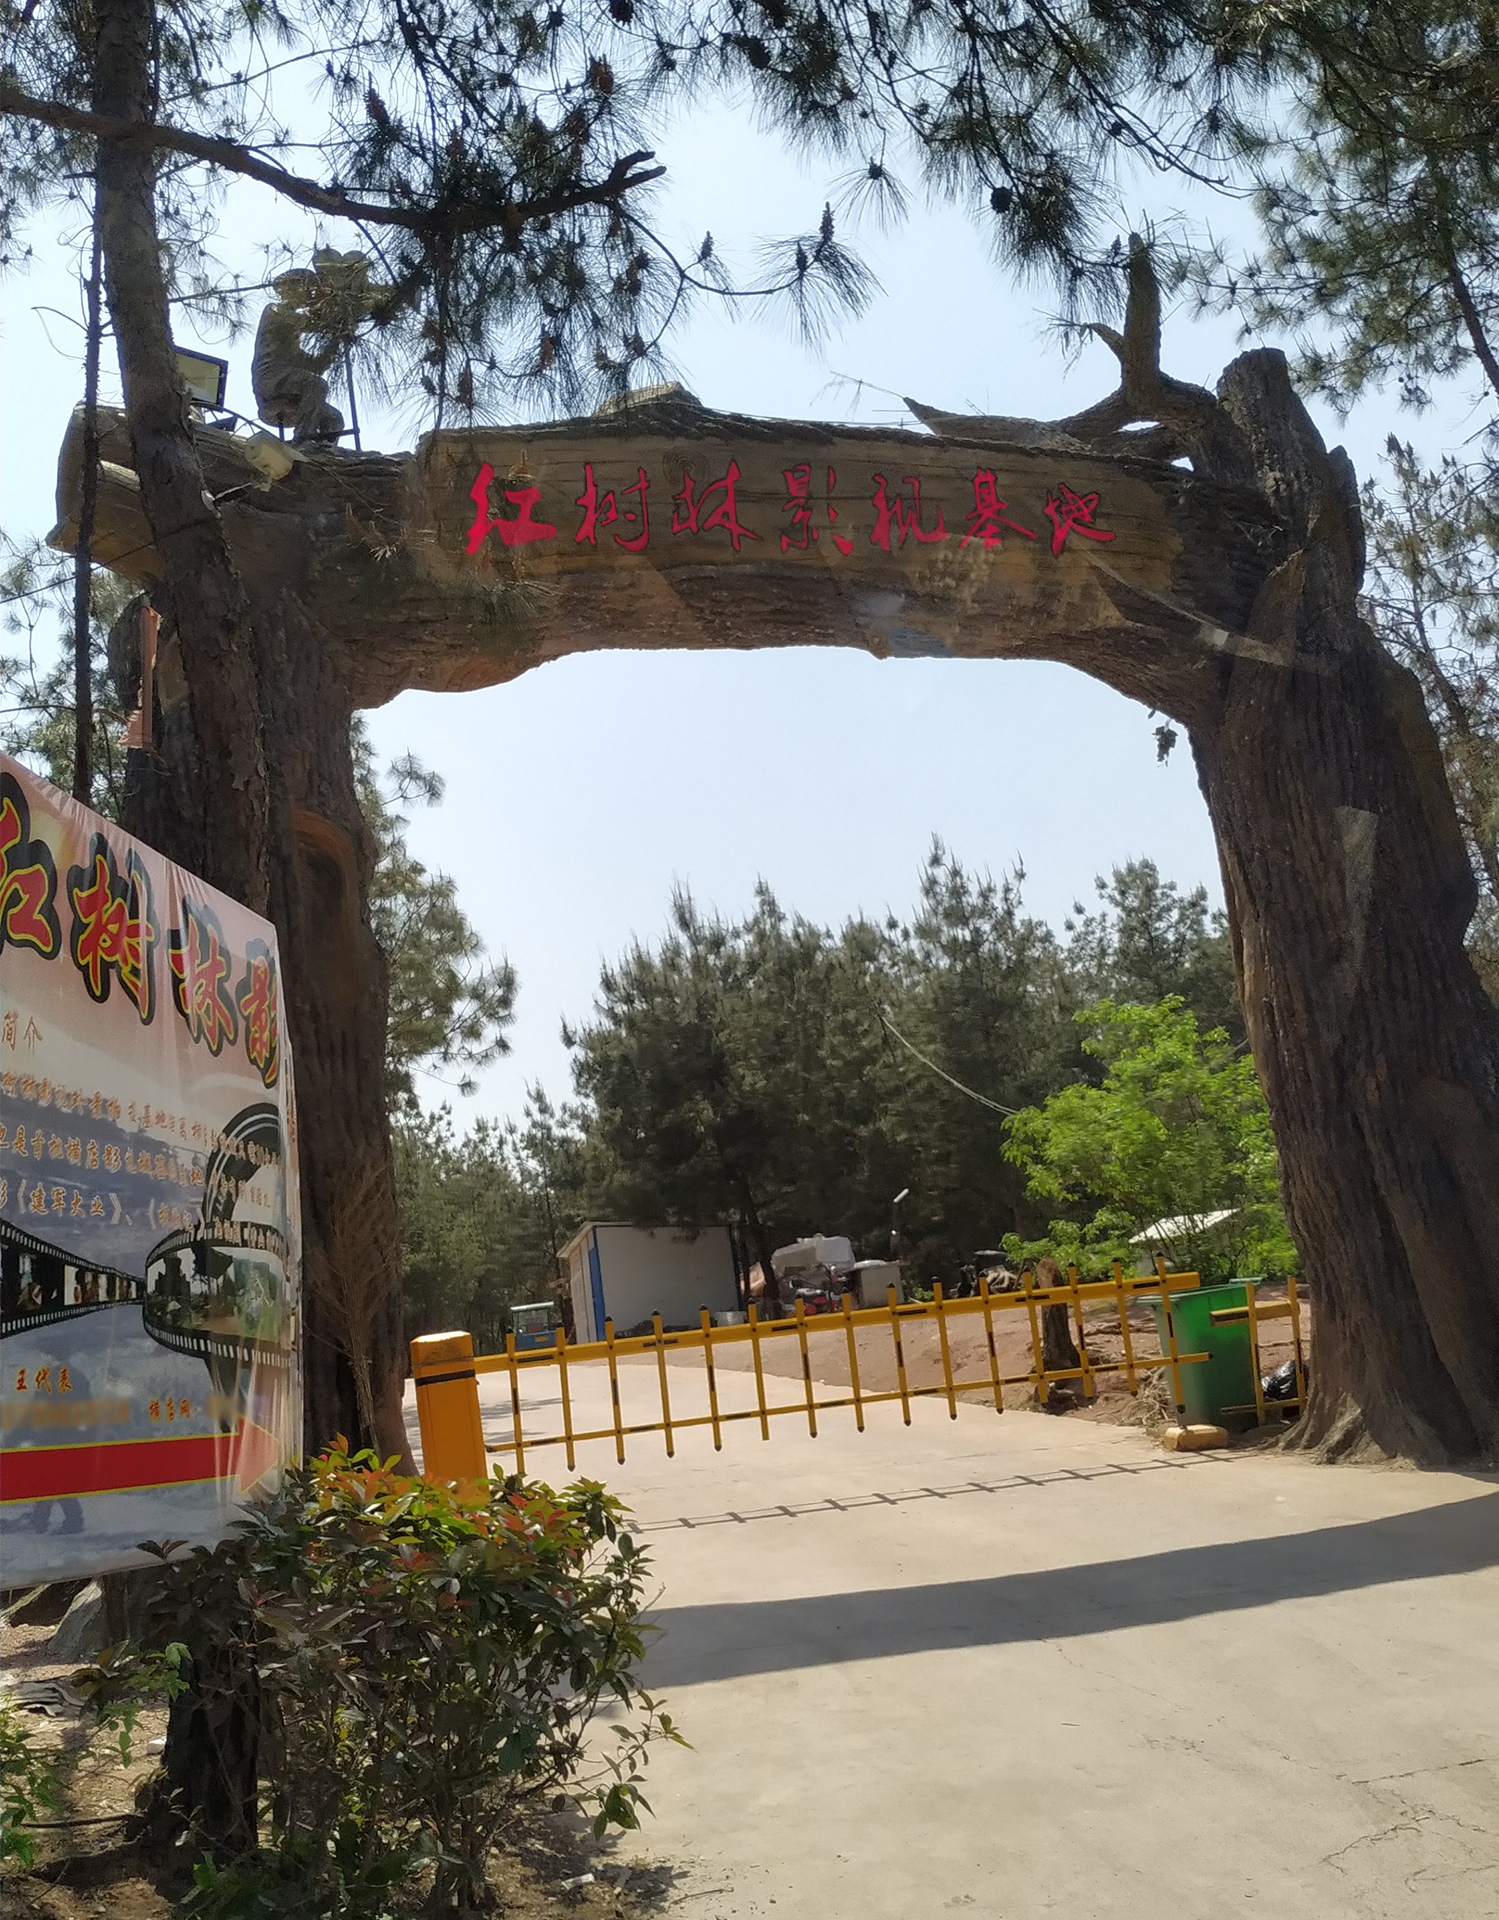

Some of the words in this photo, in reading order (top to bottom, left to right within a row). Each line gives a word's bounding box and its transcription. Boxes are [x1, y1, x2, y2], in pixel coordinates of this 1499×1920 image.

[467, 460, 1116, 557] 红树林影视基地
[16, 1364, 73, 1395] 王代表
